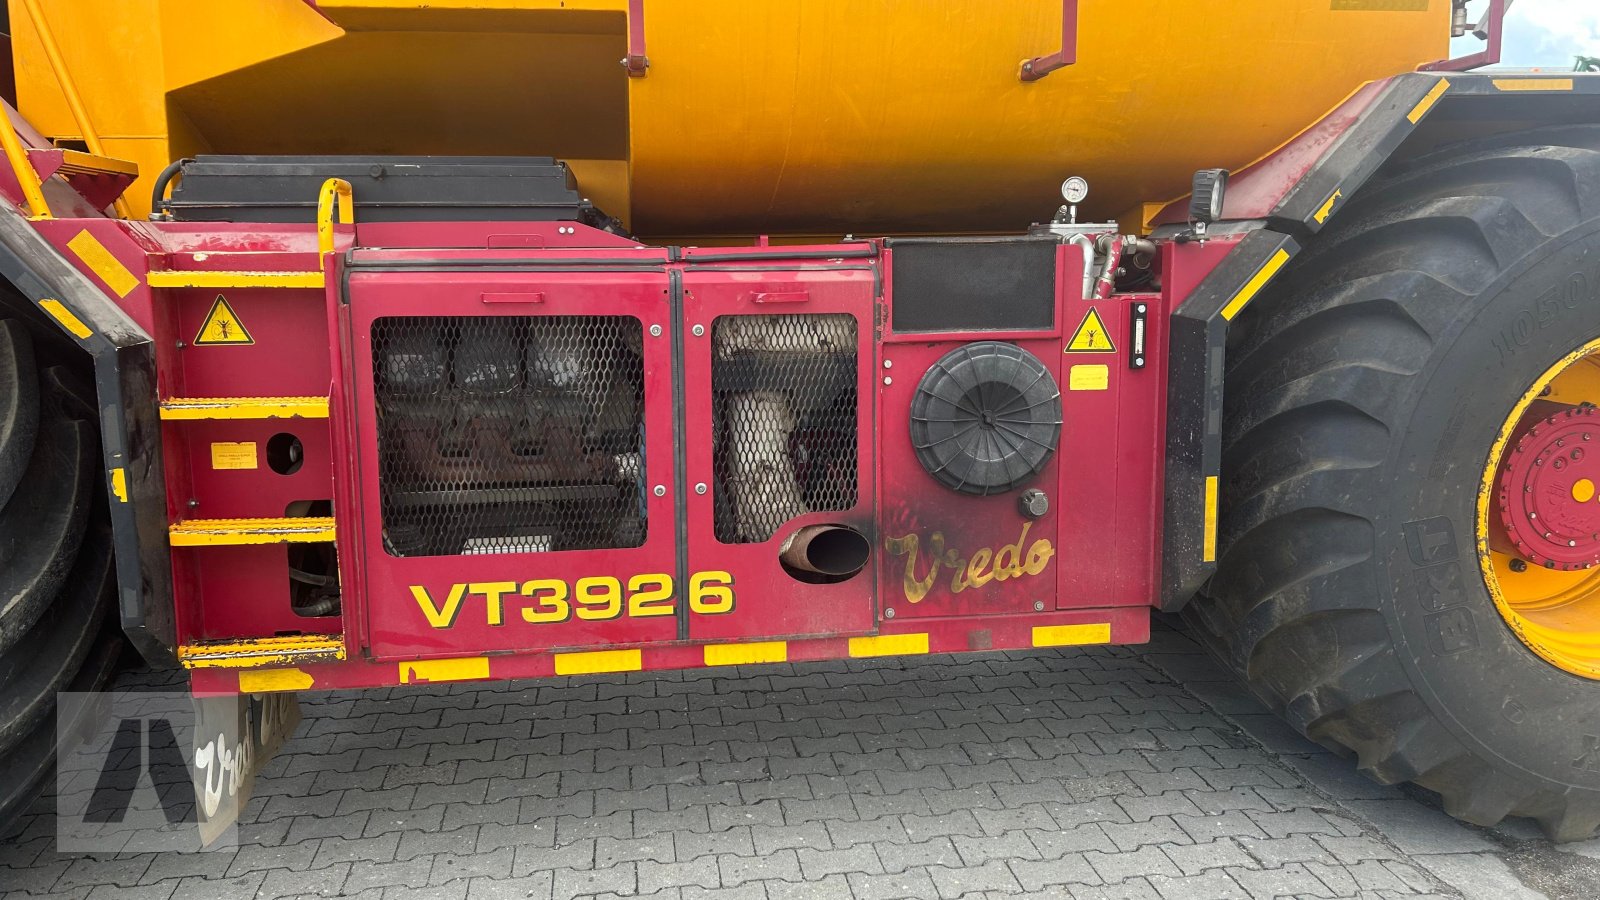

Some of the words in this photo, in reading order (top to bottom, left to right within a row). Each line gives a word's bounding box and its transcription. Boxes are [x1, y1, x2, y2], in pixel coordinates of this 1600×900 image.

[408, 570, 735, 630] VT3926
[885, 521, 1056, 605] Vredo
[1404, 515, 1478, 657] BKT
